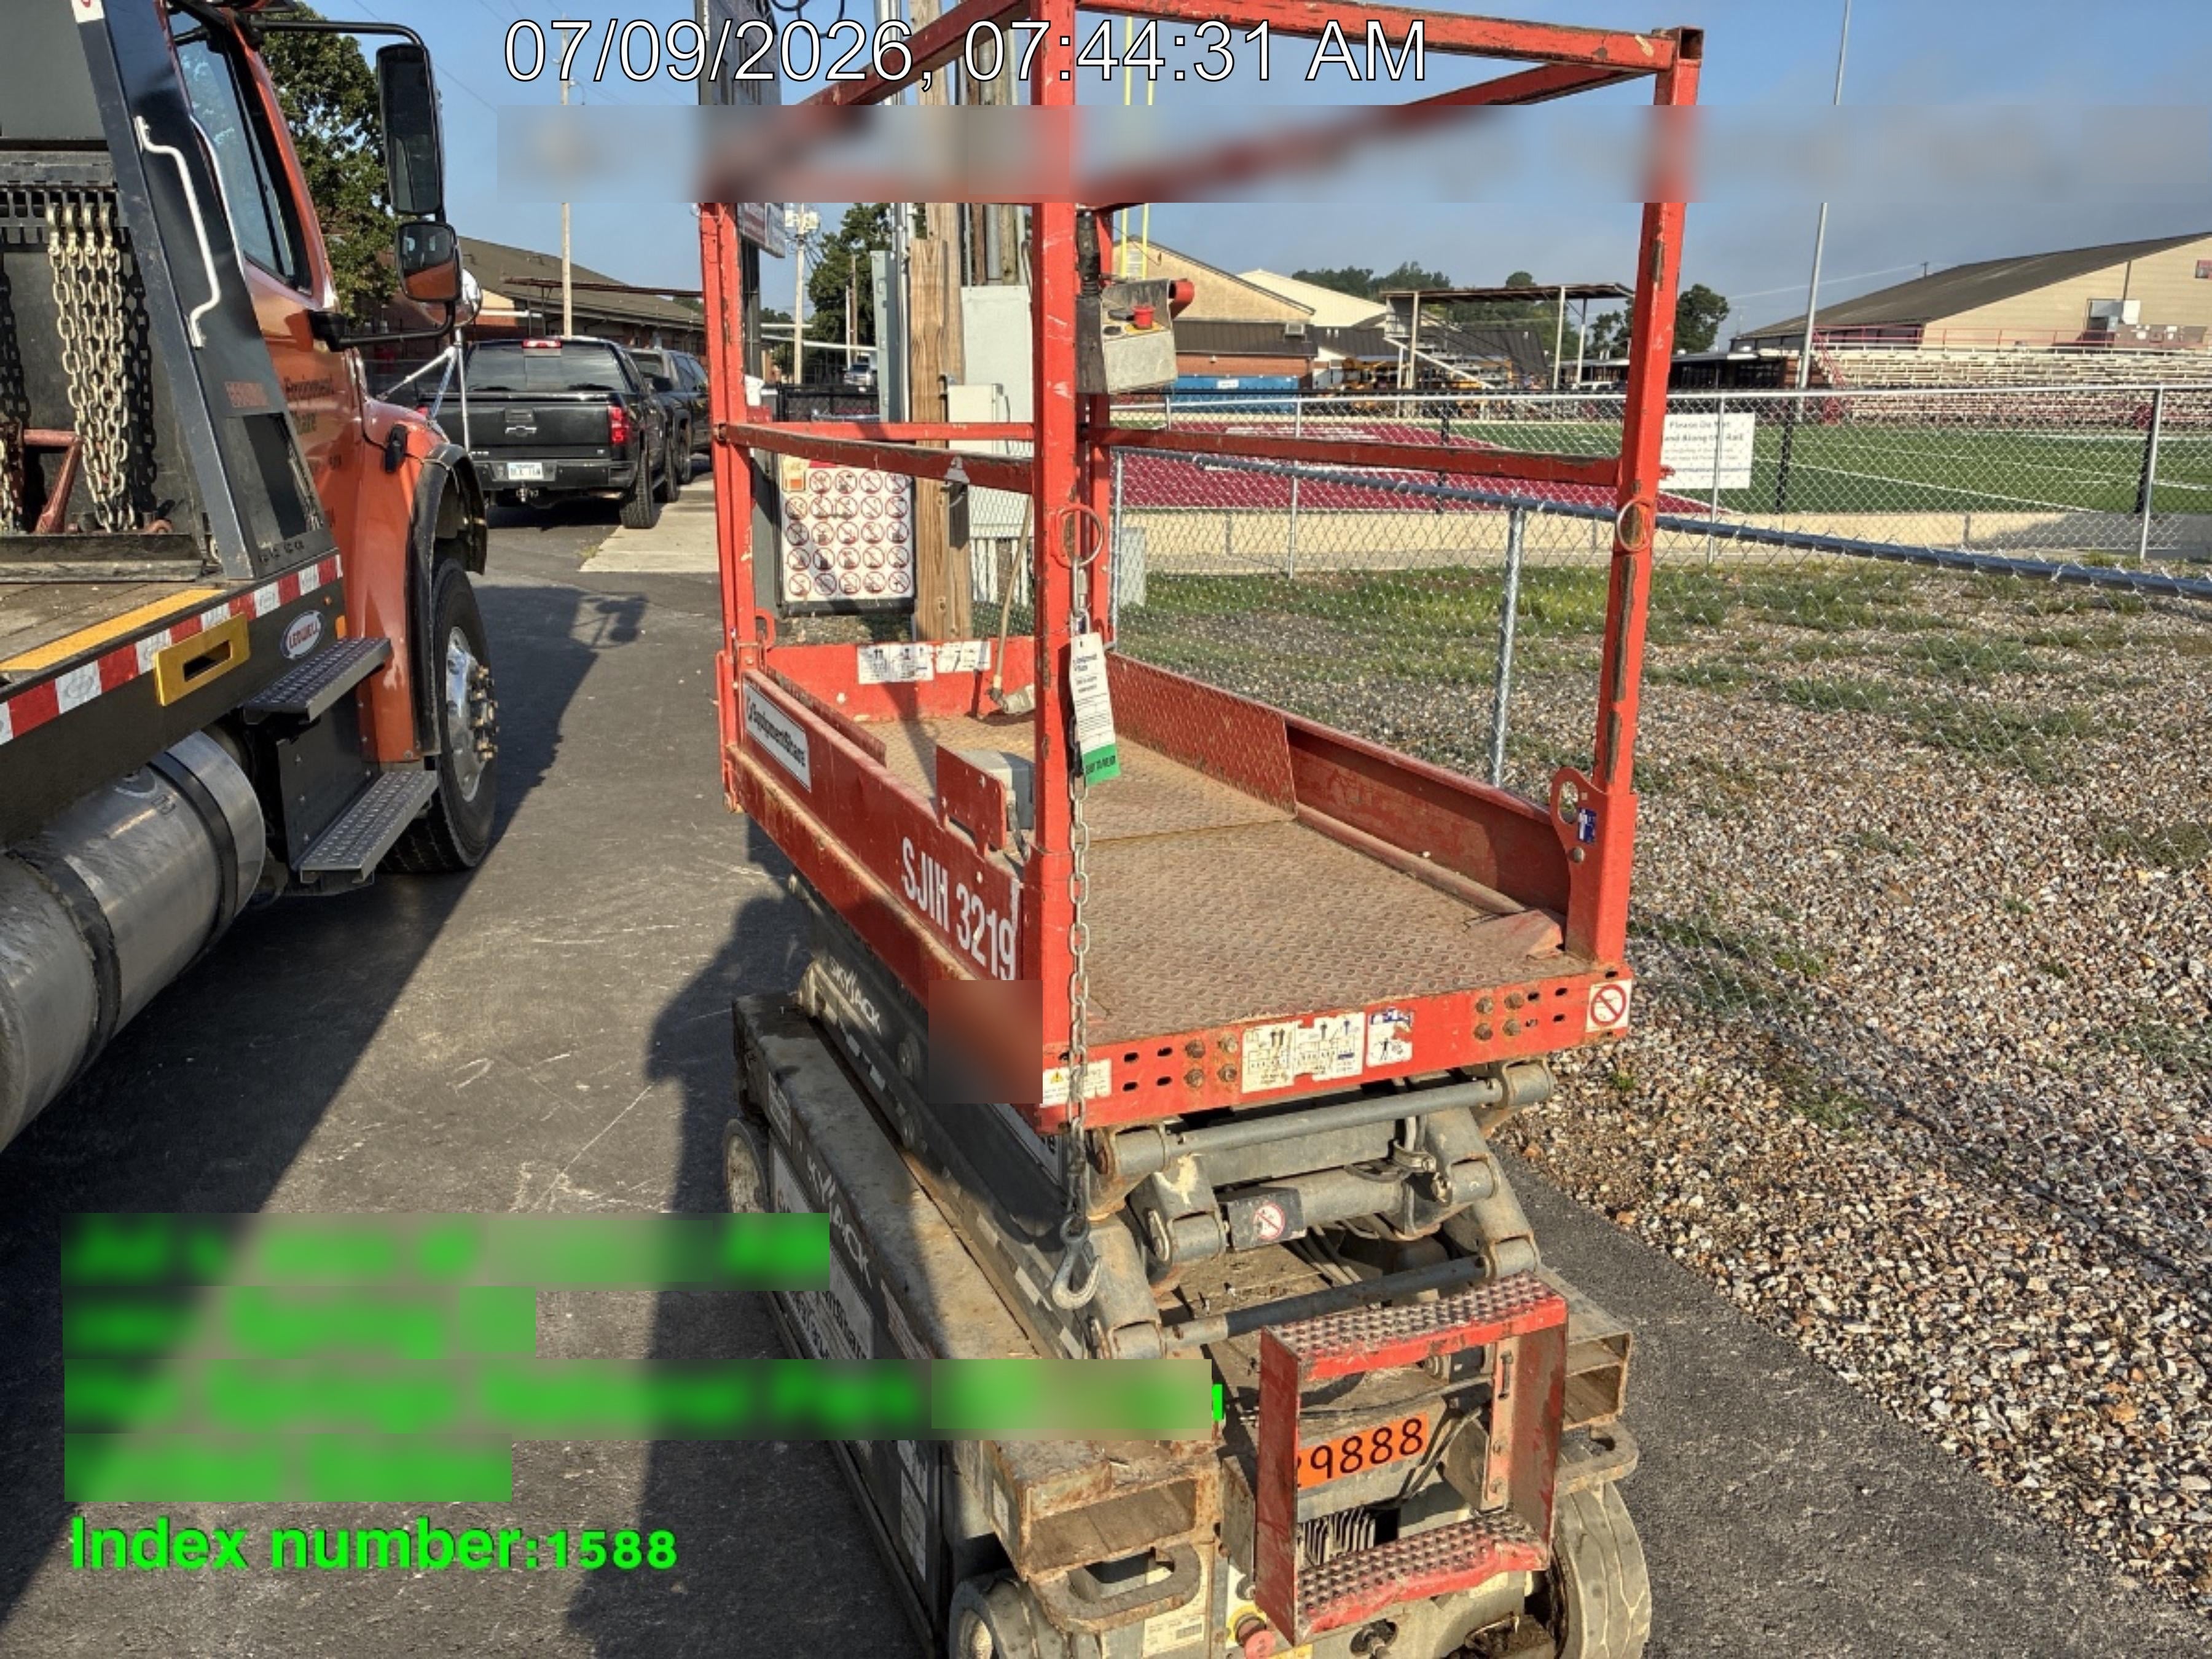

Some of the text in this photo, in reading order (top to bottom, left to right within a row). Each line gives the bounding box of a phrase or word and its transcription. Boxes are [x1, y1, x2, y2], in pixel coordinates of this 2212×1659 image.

[289, 619, 320, 649] LEDWELL
[956, 882, 1017, 981] 3219
[1298, 1418, 1423, 1488] 9888
